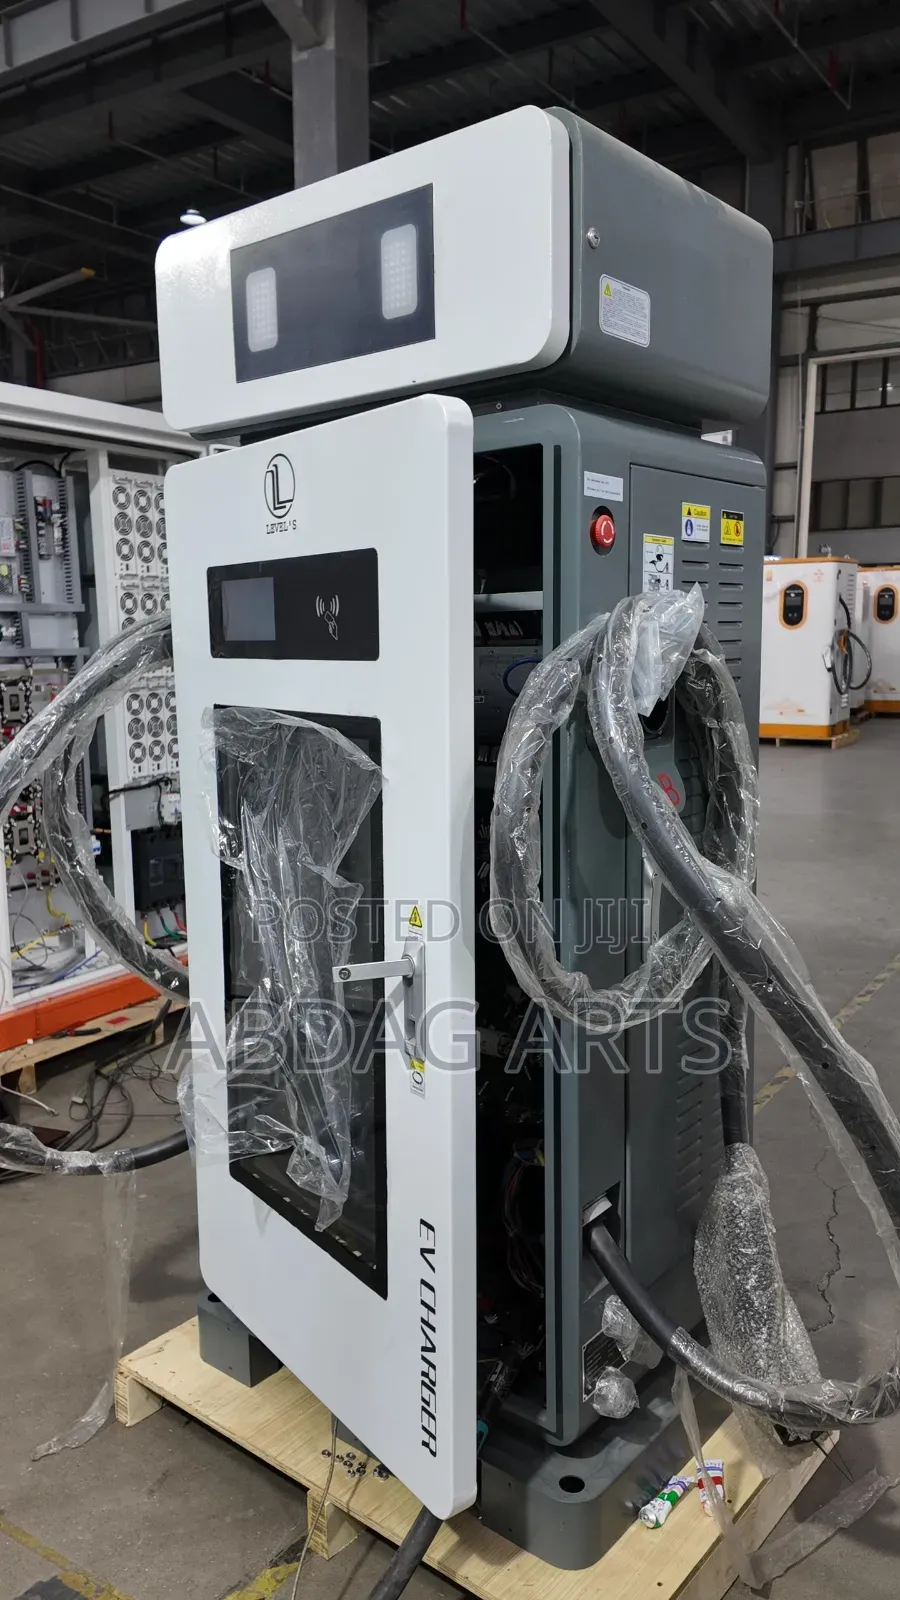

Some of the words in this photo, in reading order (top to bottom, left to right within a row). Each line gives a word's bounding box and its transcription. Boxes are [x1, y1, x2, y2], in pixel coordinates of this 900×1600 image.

[266, 519, 297, 534] LEVEL'S
[419, 1218, 436, 1274] EV
[420, 1278, 437, 1458] CHARGER
